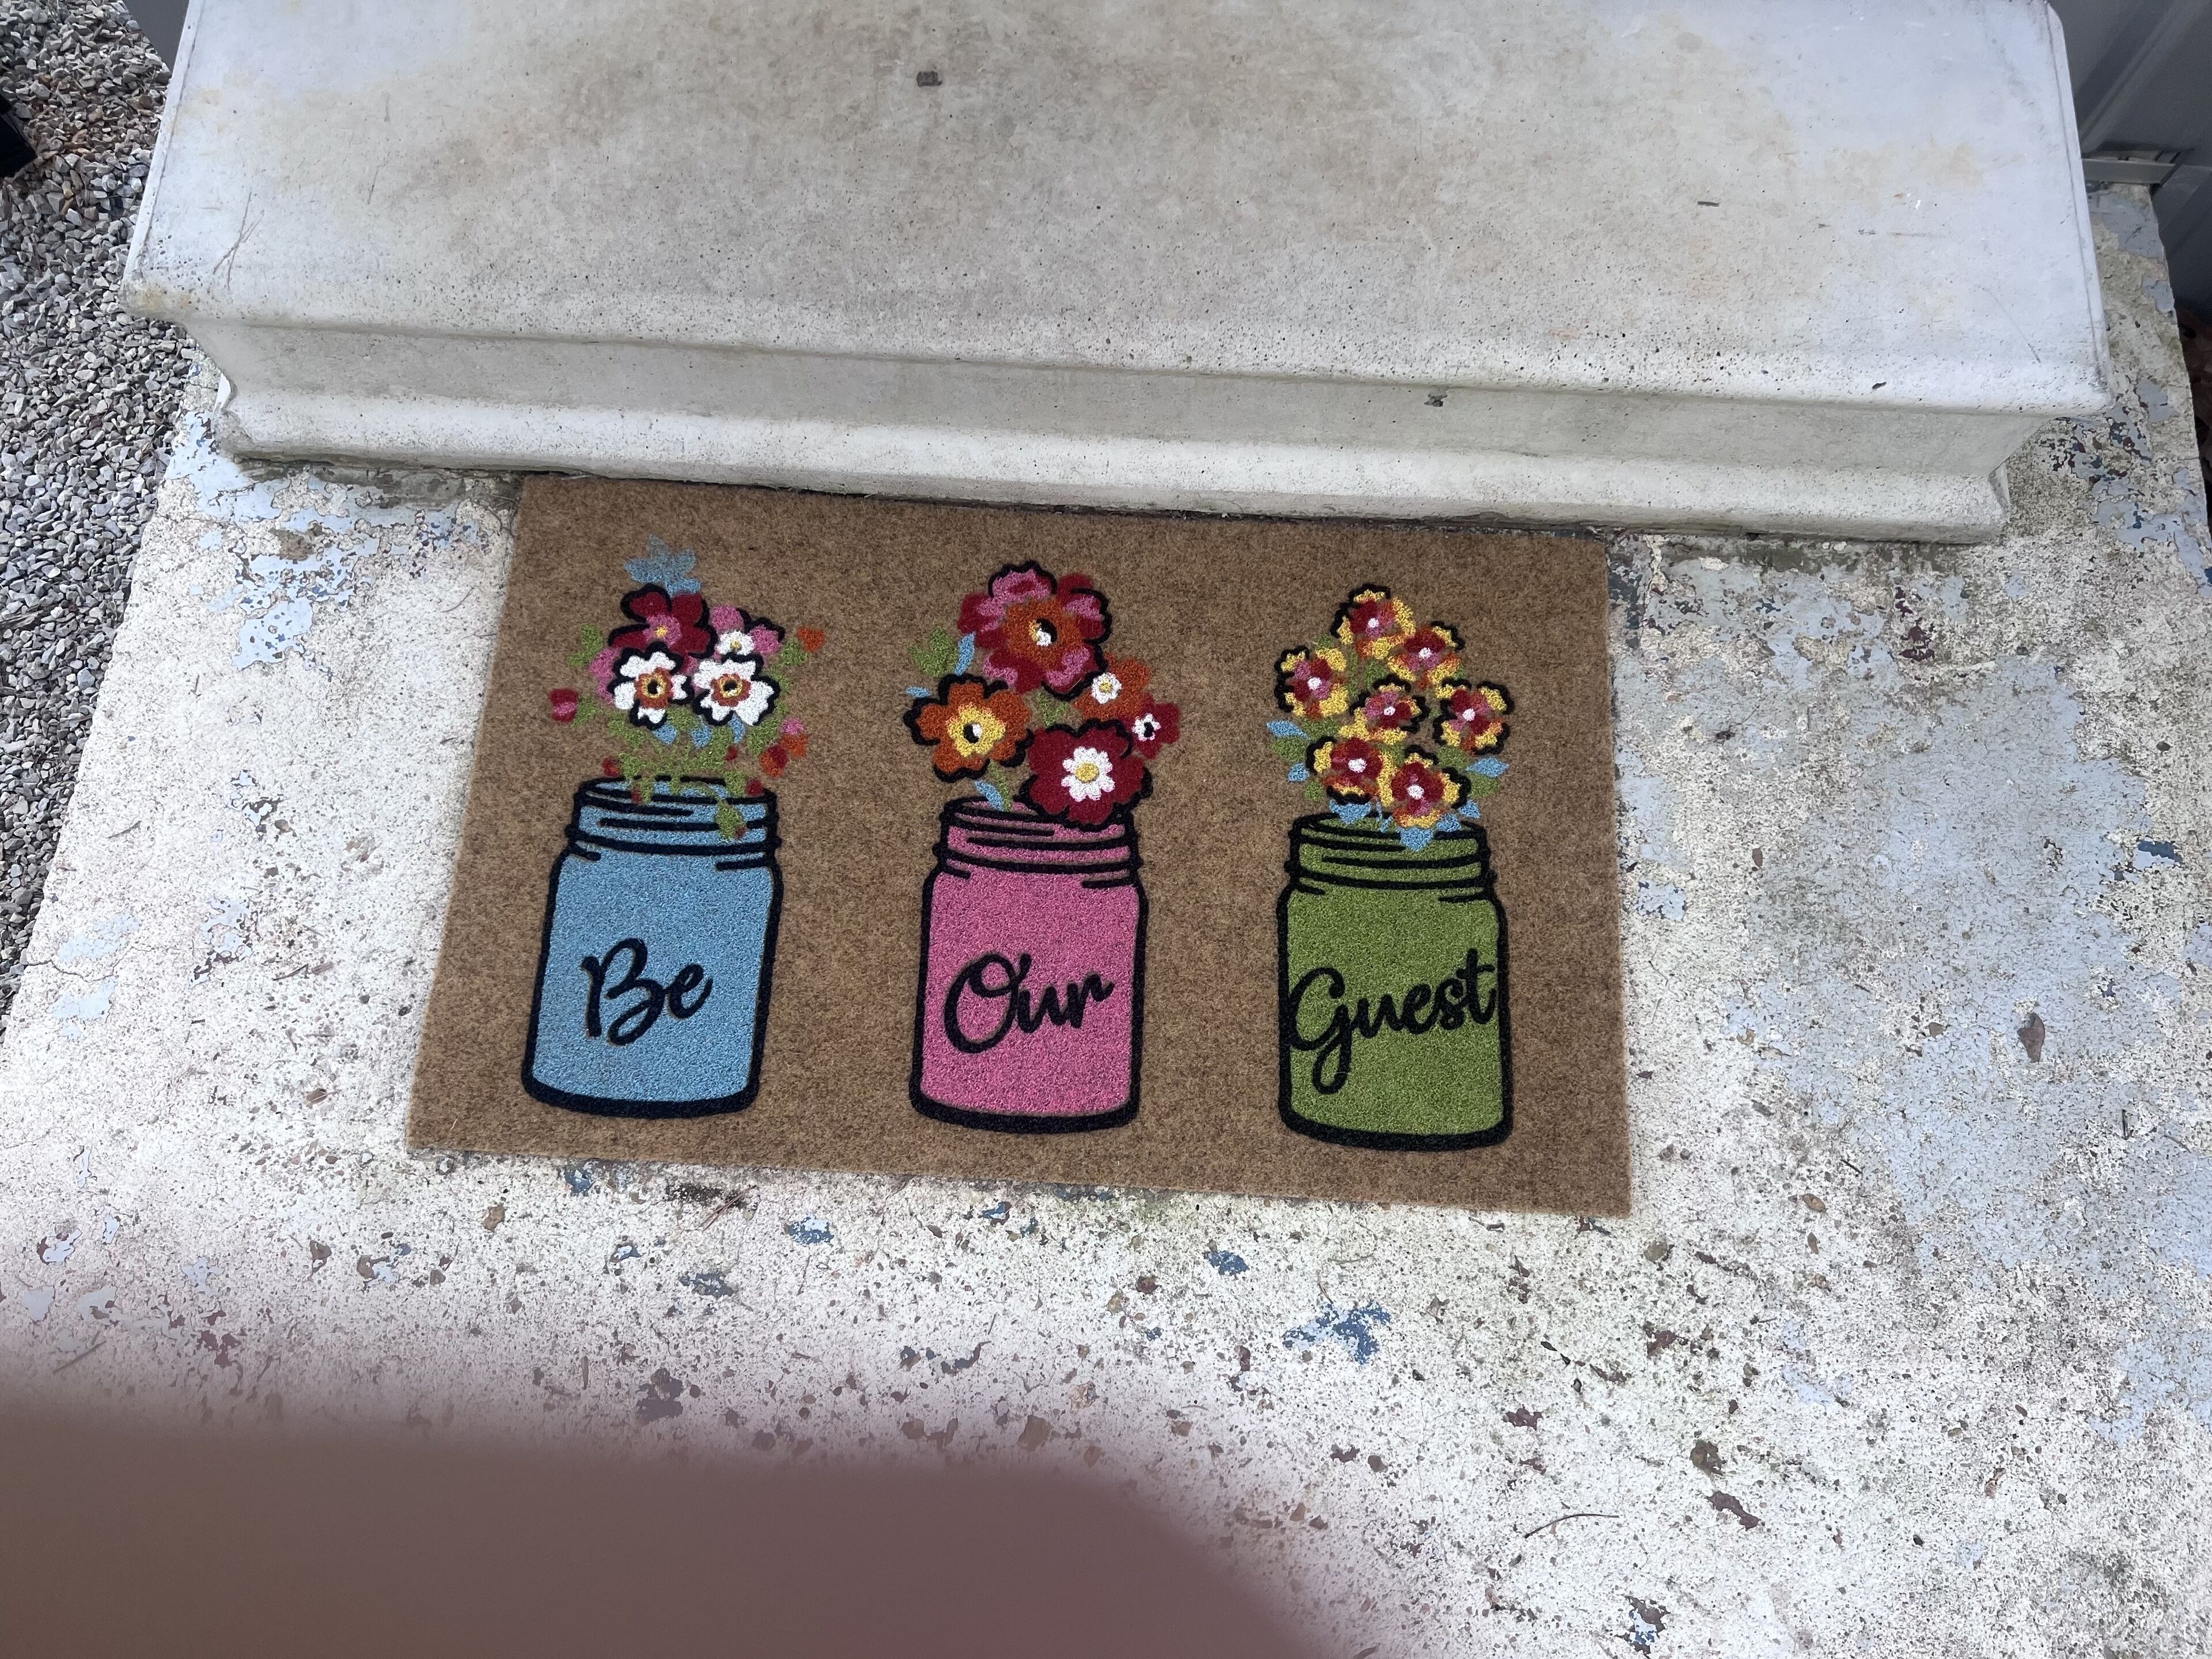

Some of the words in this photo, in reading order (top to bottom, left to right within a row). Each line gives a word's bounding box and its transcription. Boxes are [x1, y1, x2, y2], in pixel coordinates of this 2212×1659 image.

[581, 939, 713, 1046] Be
[944, 952, 1115, 1054] Our
[1290, 949, 1497, 1093] Guest
